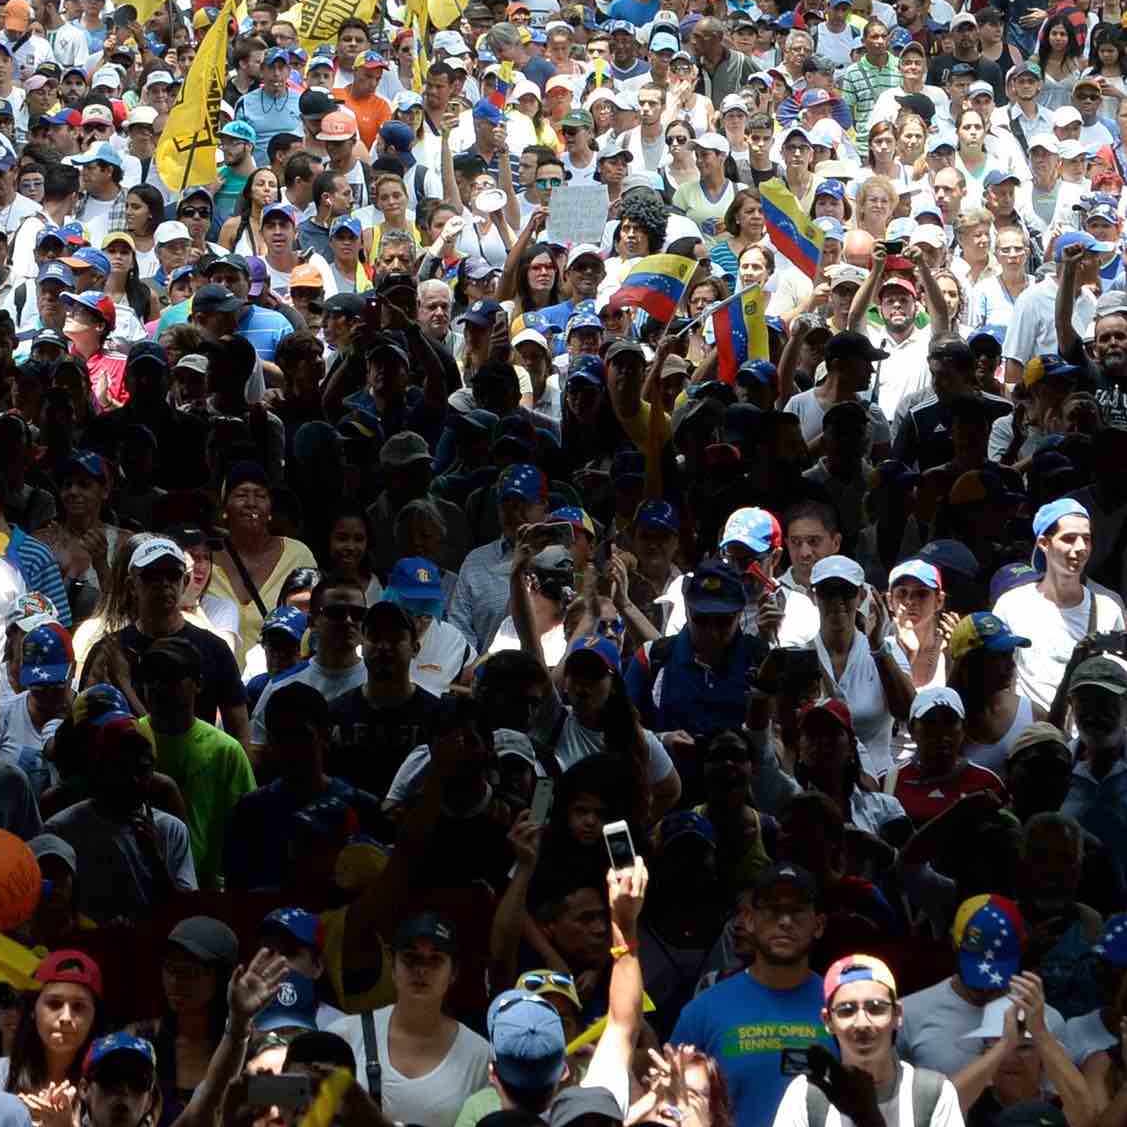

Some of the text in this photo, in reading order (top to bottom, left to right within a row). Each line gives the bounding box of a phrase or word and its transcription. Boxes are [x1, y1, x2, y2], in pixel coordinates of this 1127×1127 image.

[737, 1024, 817, 1038] SONY OPEN
[738, 1039, 783, 1052] TENNIS
